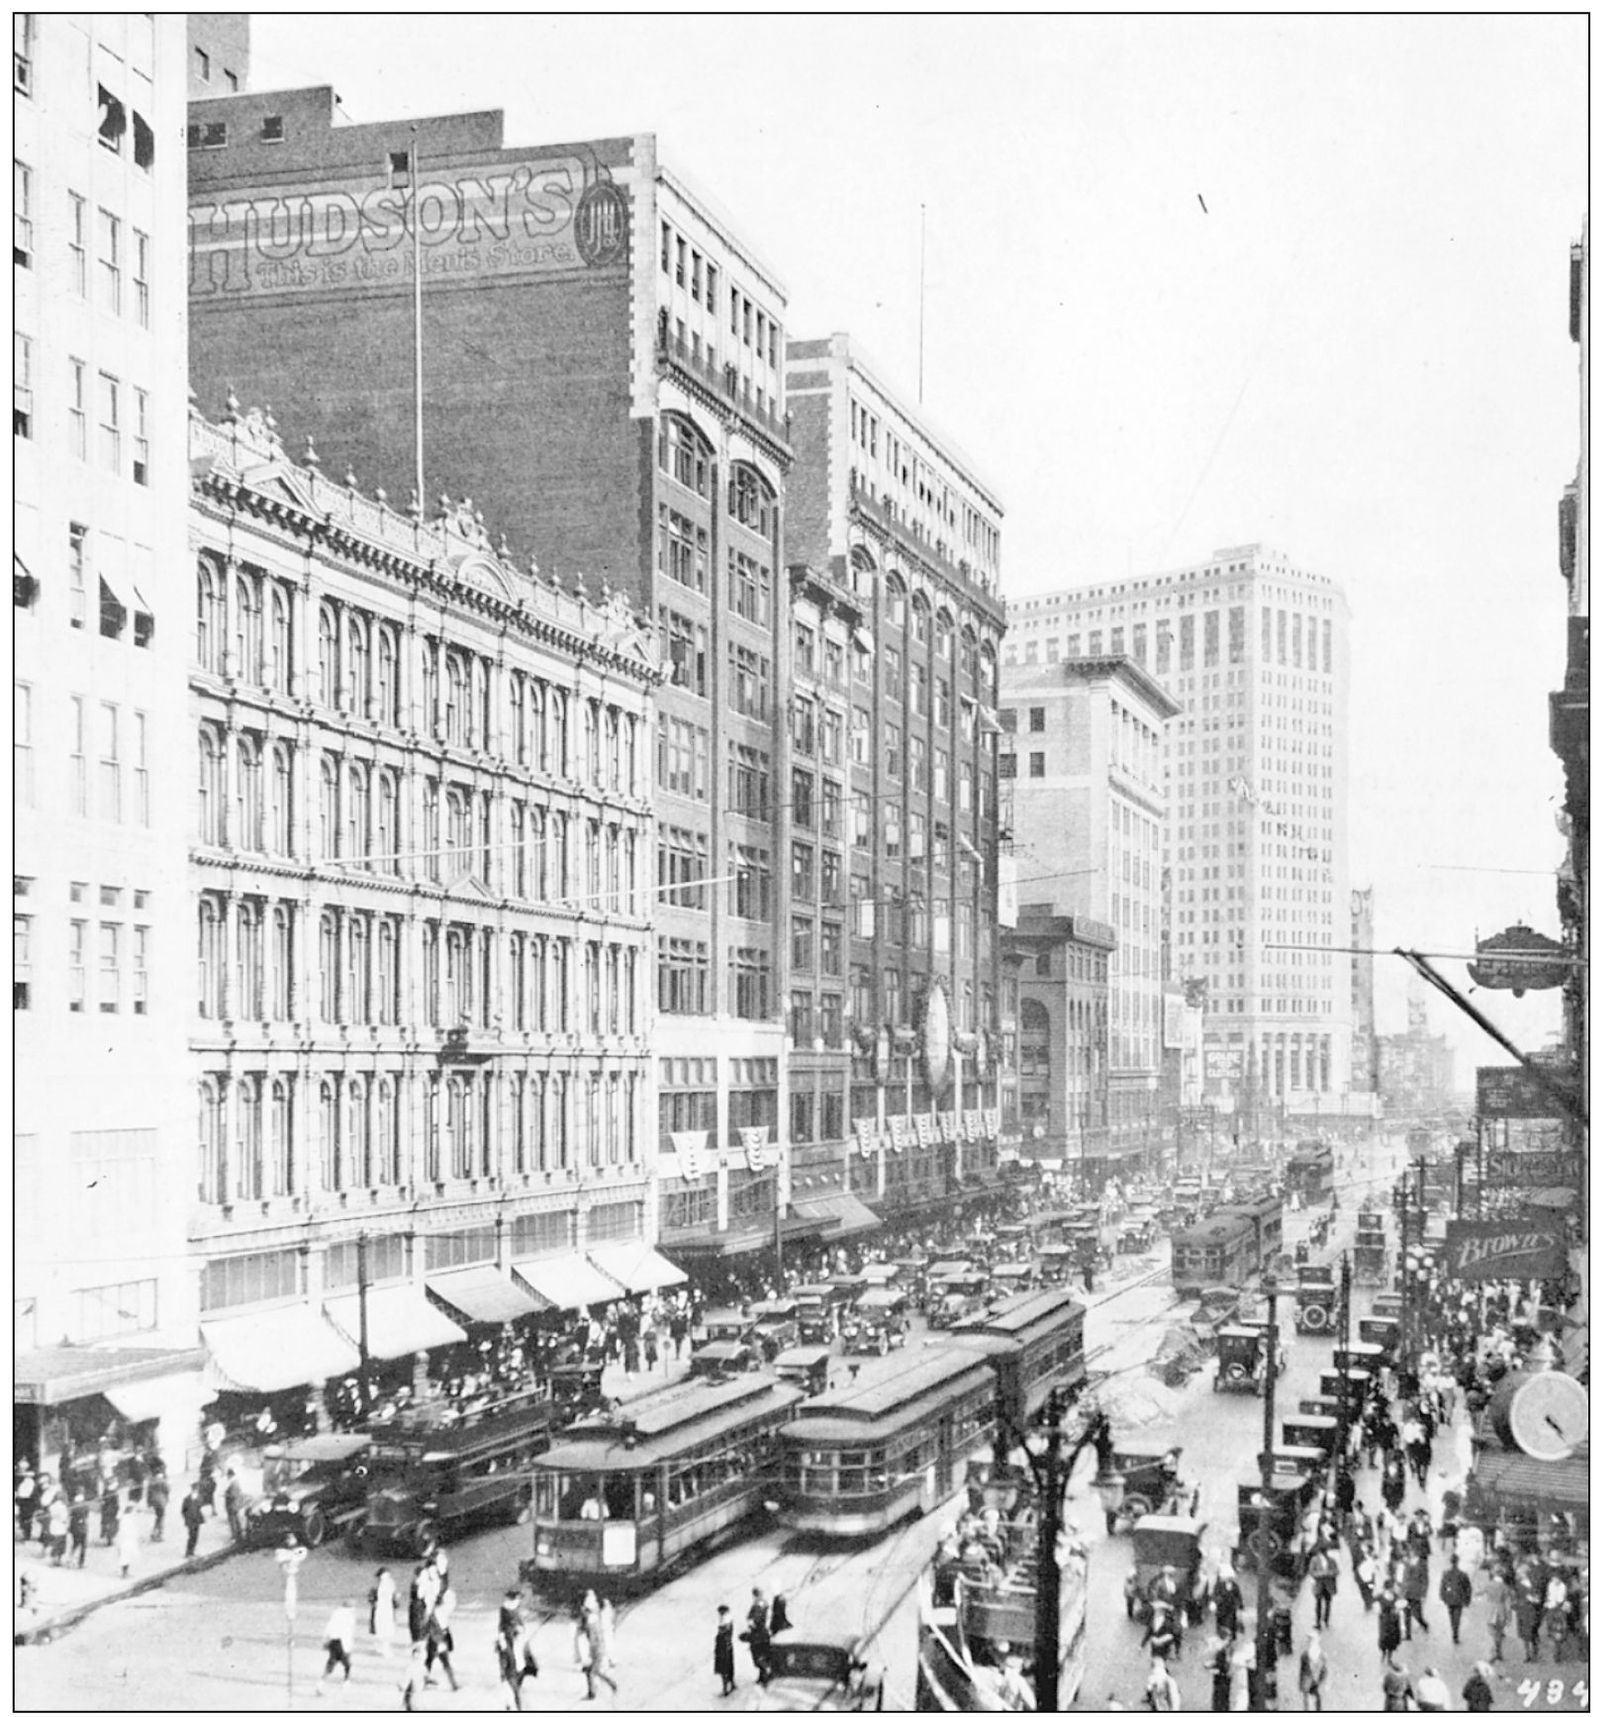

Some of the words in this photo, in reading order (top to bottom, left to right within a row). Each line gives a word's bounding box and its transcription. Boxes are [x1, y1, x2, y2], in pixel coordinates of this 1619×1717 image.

[187, 168, 574, 294] HUDSON'S
[256, 260, 316, 289] This
[319, 257, 347, 285] is
[353, 254, 399, 281] the
